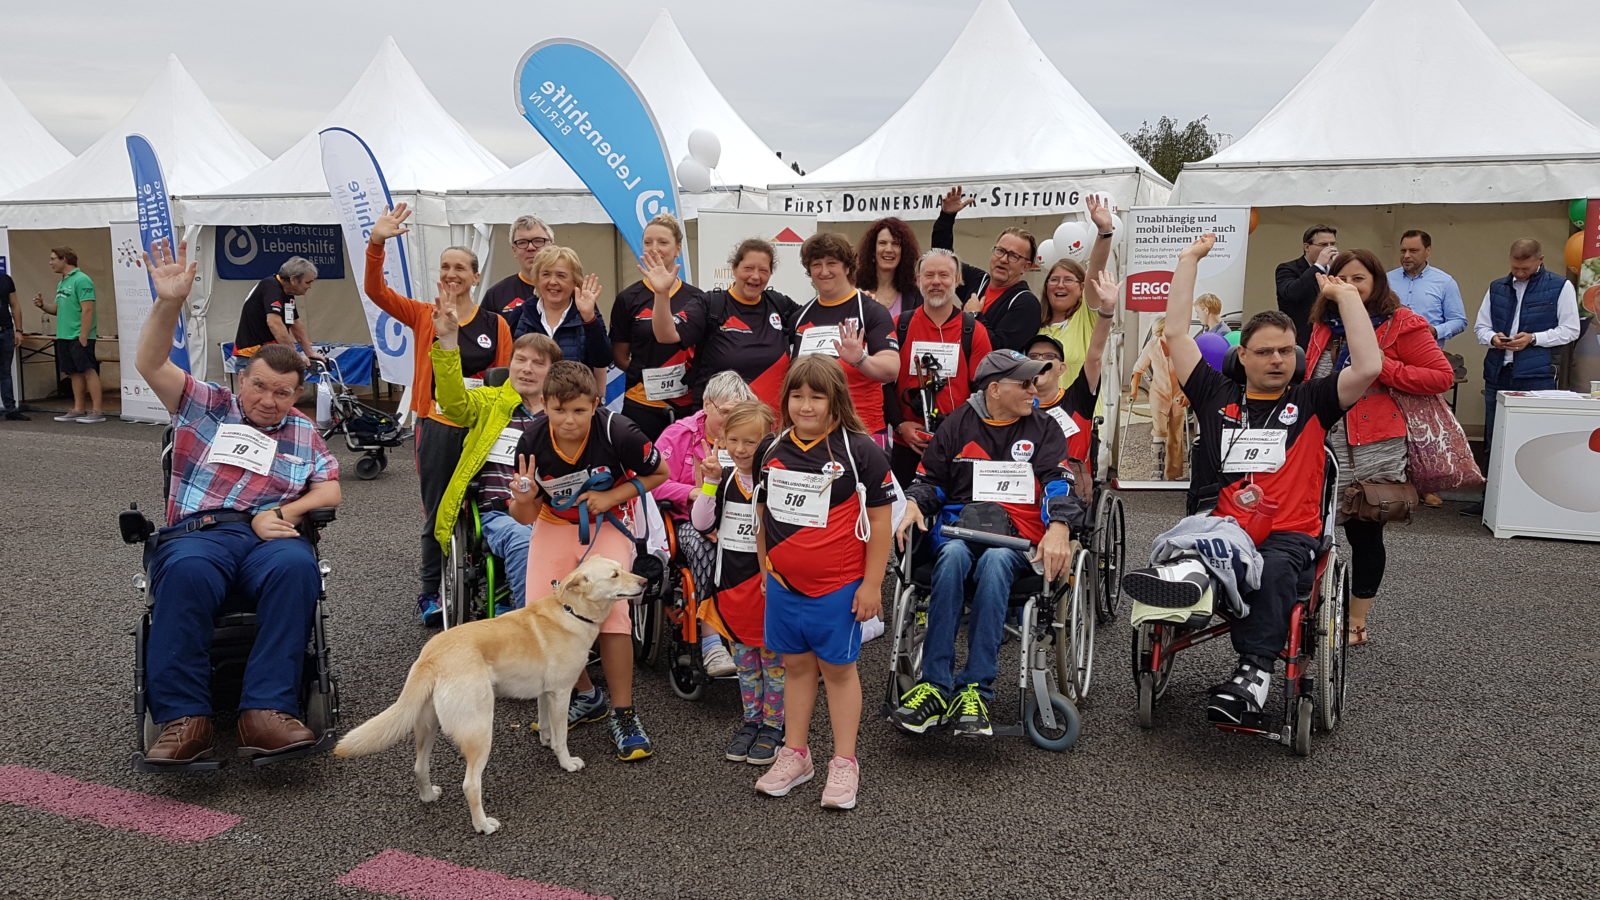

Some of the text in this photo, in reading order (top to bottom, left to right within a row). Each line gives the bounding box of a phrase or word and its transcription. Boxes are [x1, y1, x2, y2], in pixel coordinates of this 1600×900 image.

[784, 198, 833, 213] FÜRST
[1136, 214, 1217, 224] Unabhängig und
[282, 226, 335, 237] SPORTCLUB
[1136, 224, 1164, 233] mobil
[1167, 224, 1202, 233] bleiben
[1212, 224, 1236, 233] auch
[1135, 234, 1159, 243] nach
[1161, 235, 1192, 243] einem
[262, 238, 335, 254] Lebenshilfe
[1132, 282, 1170, 295] ERGO
[660, 380, 674, 389] 514
[231, 443, 249, 455] 19
[1016, 443, 1021, 451] I
[1244, 448, 1259, 460] 19
[996, 481, 1010, 491] 18
[784, 492, 806, 507] 518
[1210, 559, 1230, 570] EST.
